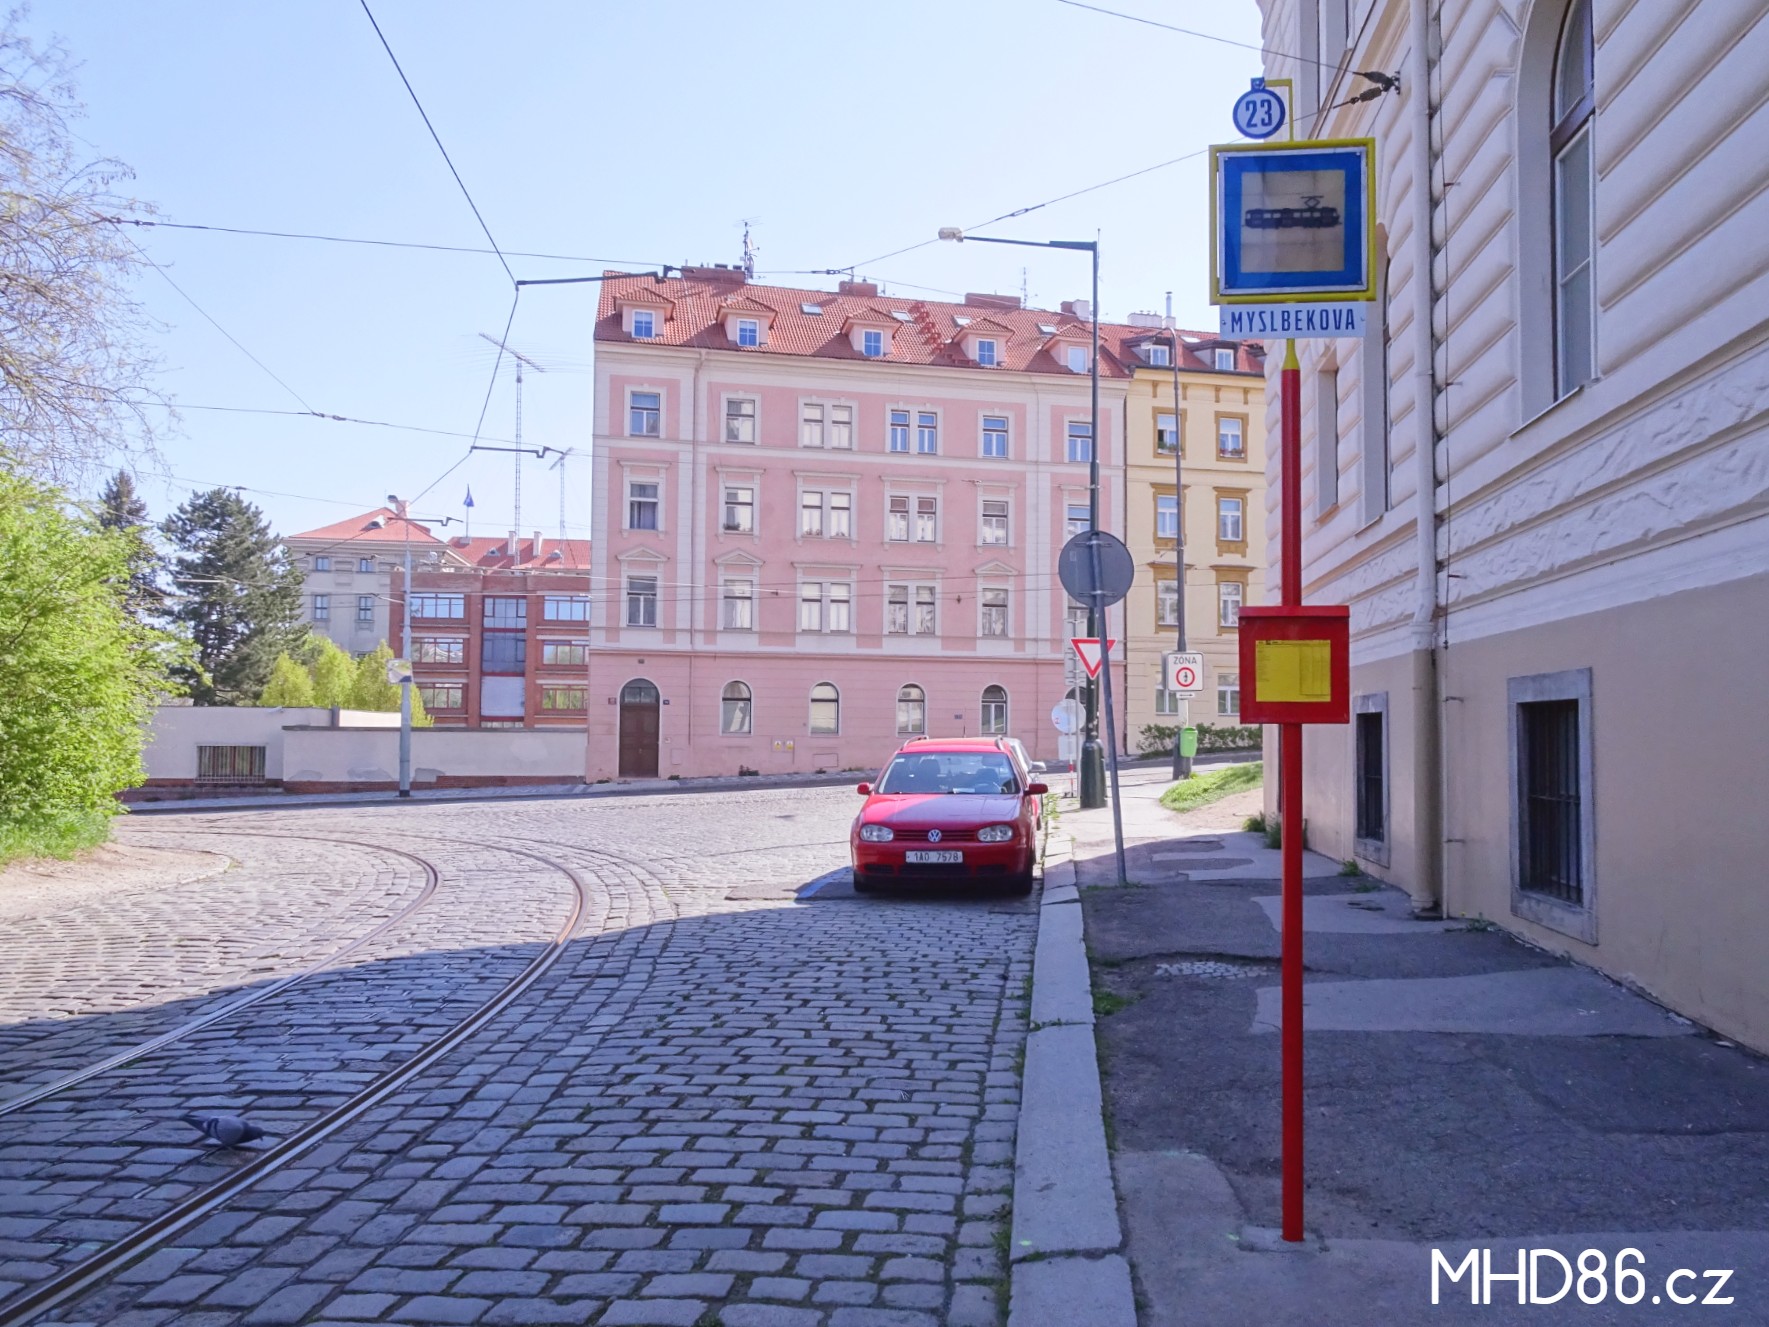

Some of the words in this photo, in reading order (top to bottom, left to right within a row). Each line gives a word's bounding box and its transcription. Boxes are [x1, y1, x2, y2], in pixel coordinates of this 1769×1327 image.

[1245, 98, 1272, 128] 23
[1231, 308, 1356, 333] MYSLBEKOVA
[936, 852, 959, 862] 7578
